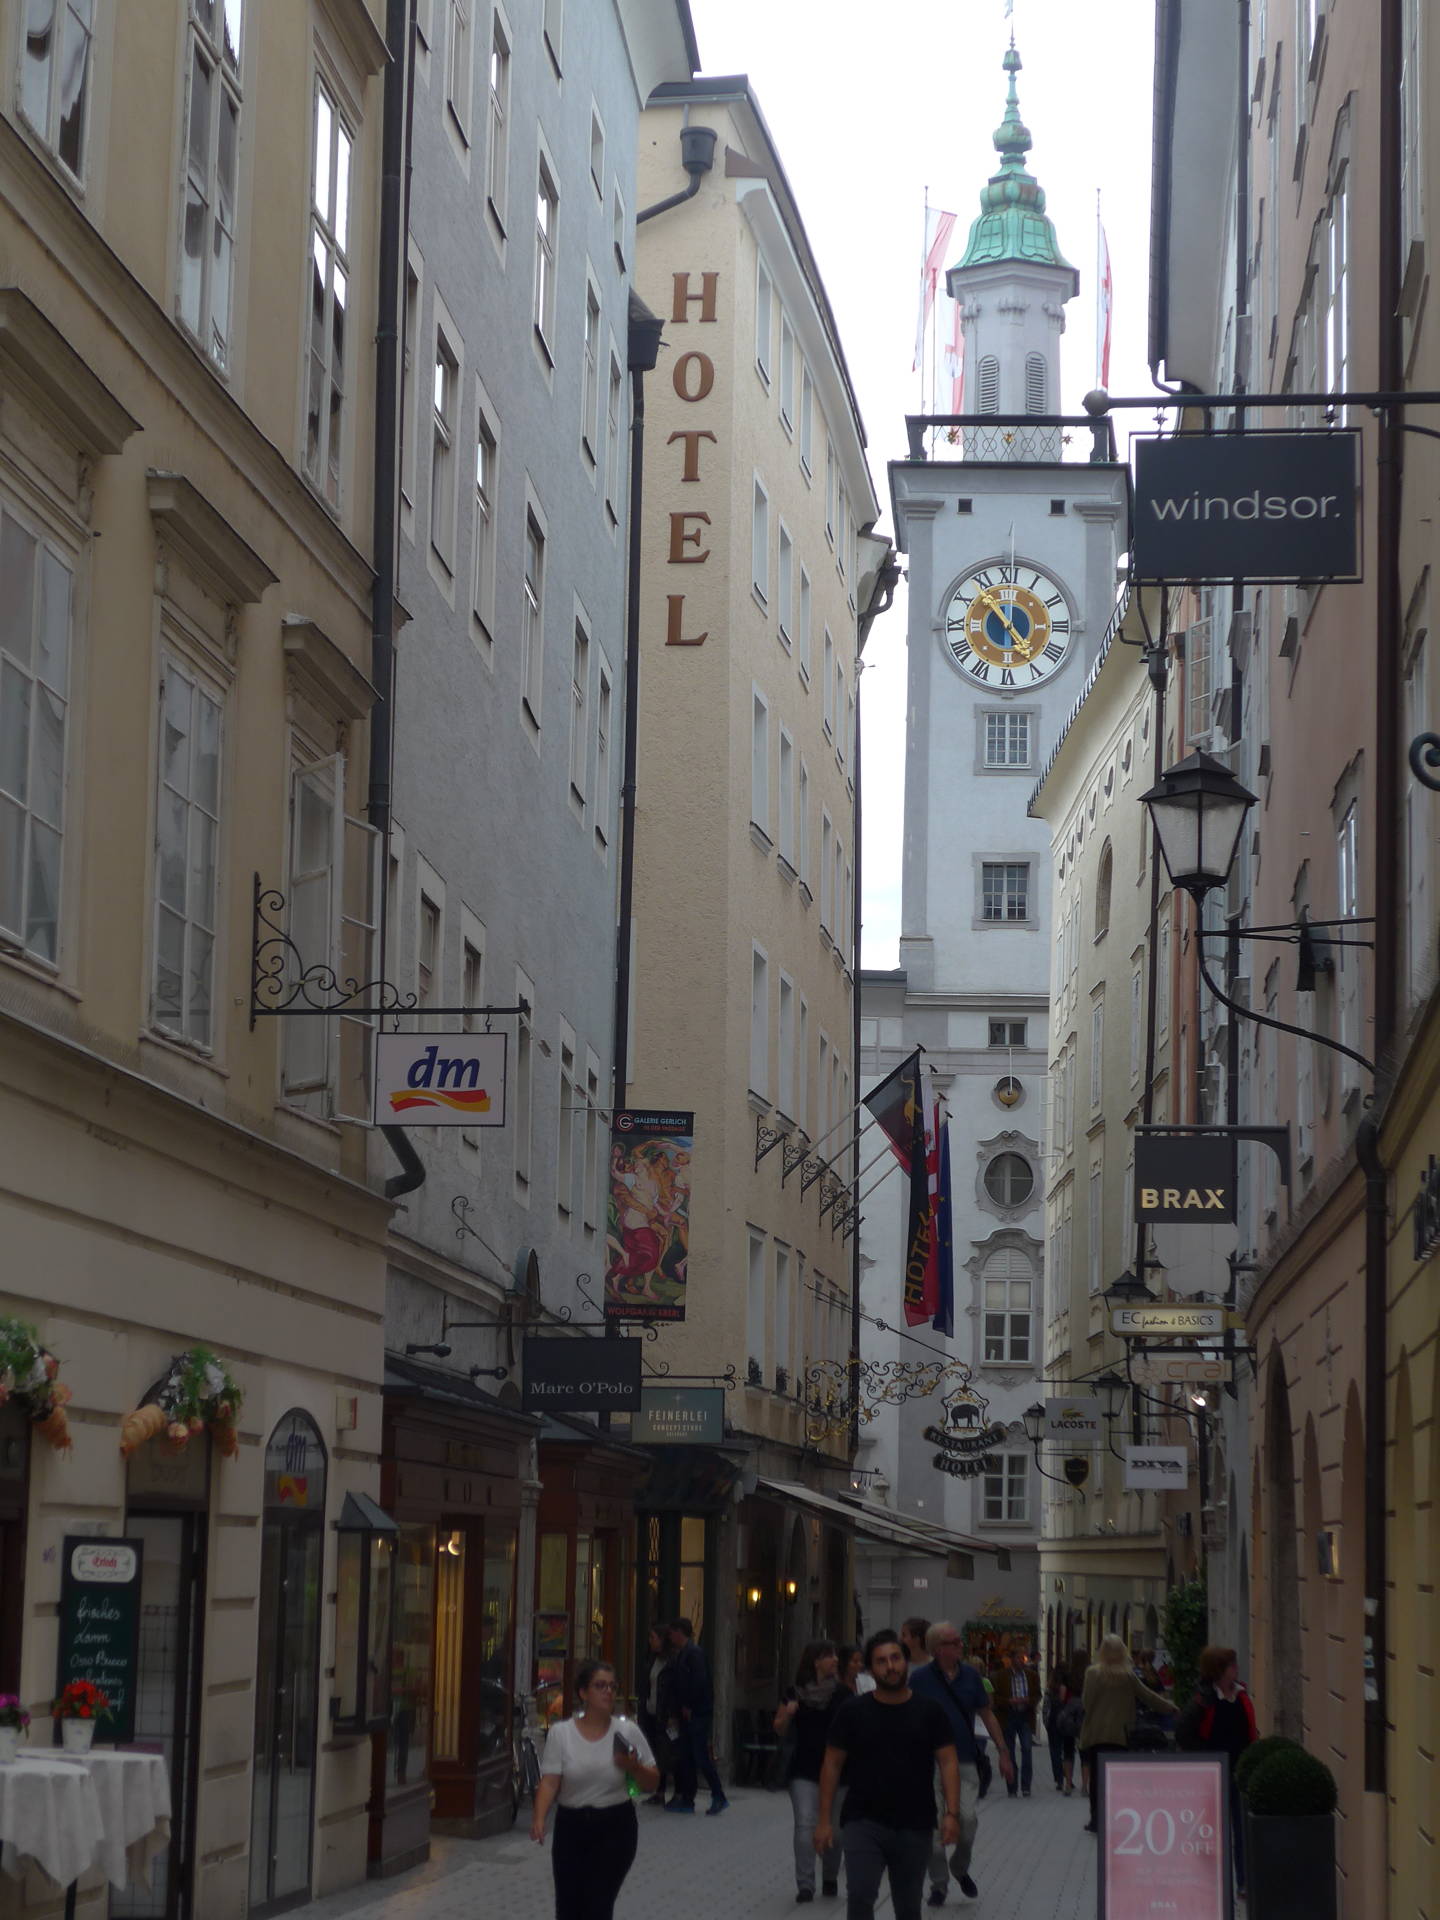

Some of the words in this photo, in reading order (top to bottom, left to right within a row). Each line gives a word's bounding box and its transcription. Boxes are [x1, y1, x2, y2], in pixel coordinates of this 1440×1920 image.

[665, 272, 719, 647] HOTEL
[1151, 489, 1341, 520] windsor.
[407, 1046, 480, 1088] dm
[660, 1118, 687, 1126] GERLICH
[1141, 1188, 1225, 1209] BRAX
[1122, 1311, 1140, 1324] EC
[530, 1382, 574, 1394] Marc
[579, 1382, 633, 1394] O'Polo
[648, 1409, 707, 1422] FEINERLEI
[1051, 1420, 1097, 1429] LACOSTE
[929, 1431, 1001, 1450] RESTAURANT
[940, 1458, 988, 1473] HOTEL
[1131, 1460, 1183, 1468] DIVA
[1180, 1841, 1213, 1855] OFF
